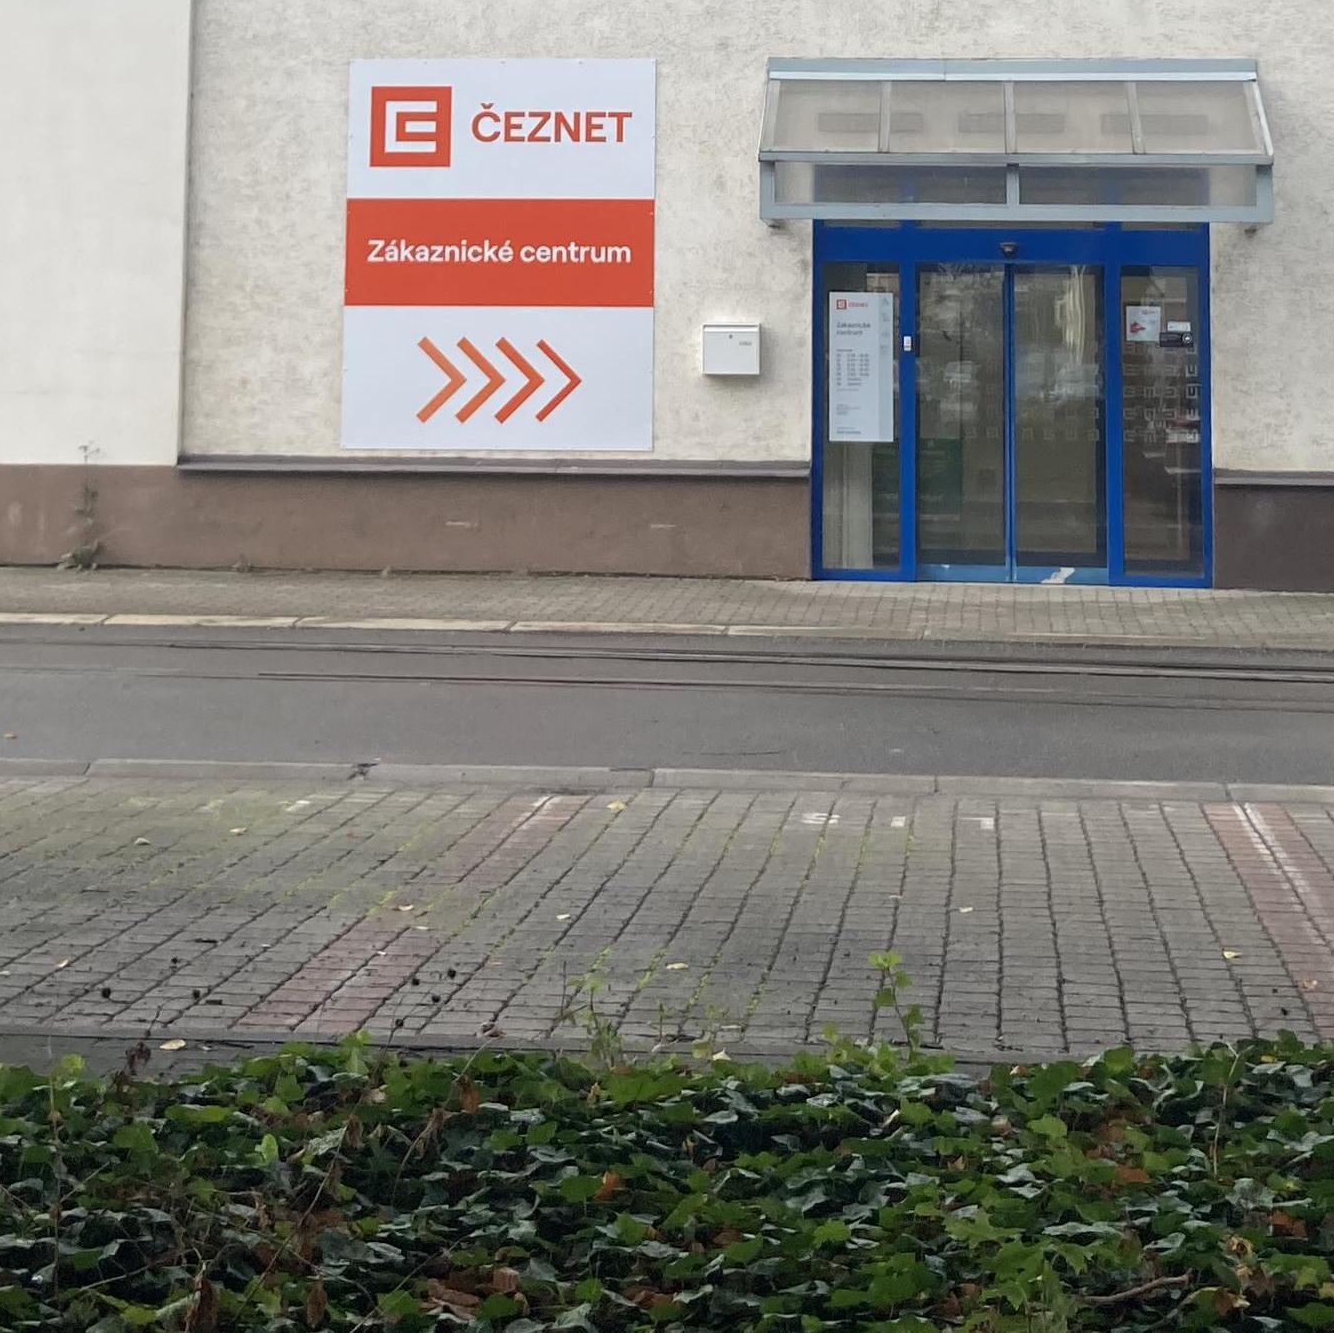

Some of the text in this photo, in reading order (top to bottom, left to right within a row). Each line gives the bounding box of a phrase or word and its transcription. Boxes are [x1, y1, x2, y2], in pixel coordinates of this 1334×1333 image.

[471, 103, 633, 143] ČEZNET
[367, 240, 632, 263] Zákaznické centrum
